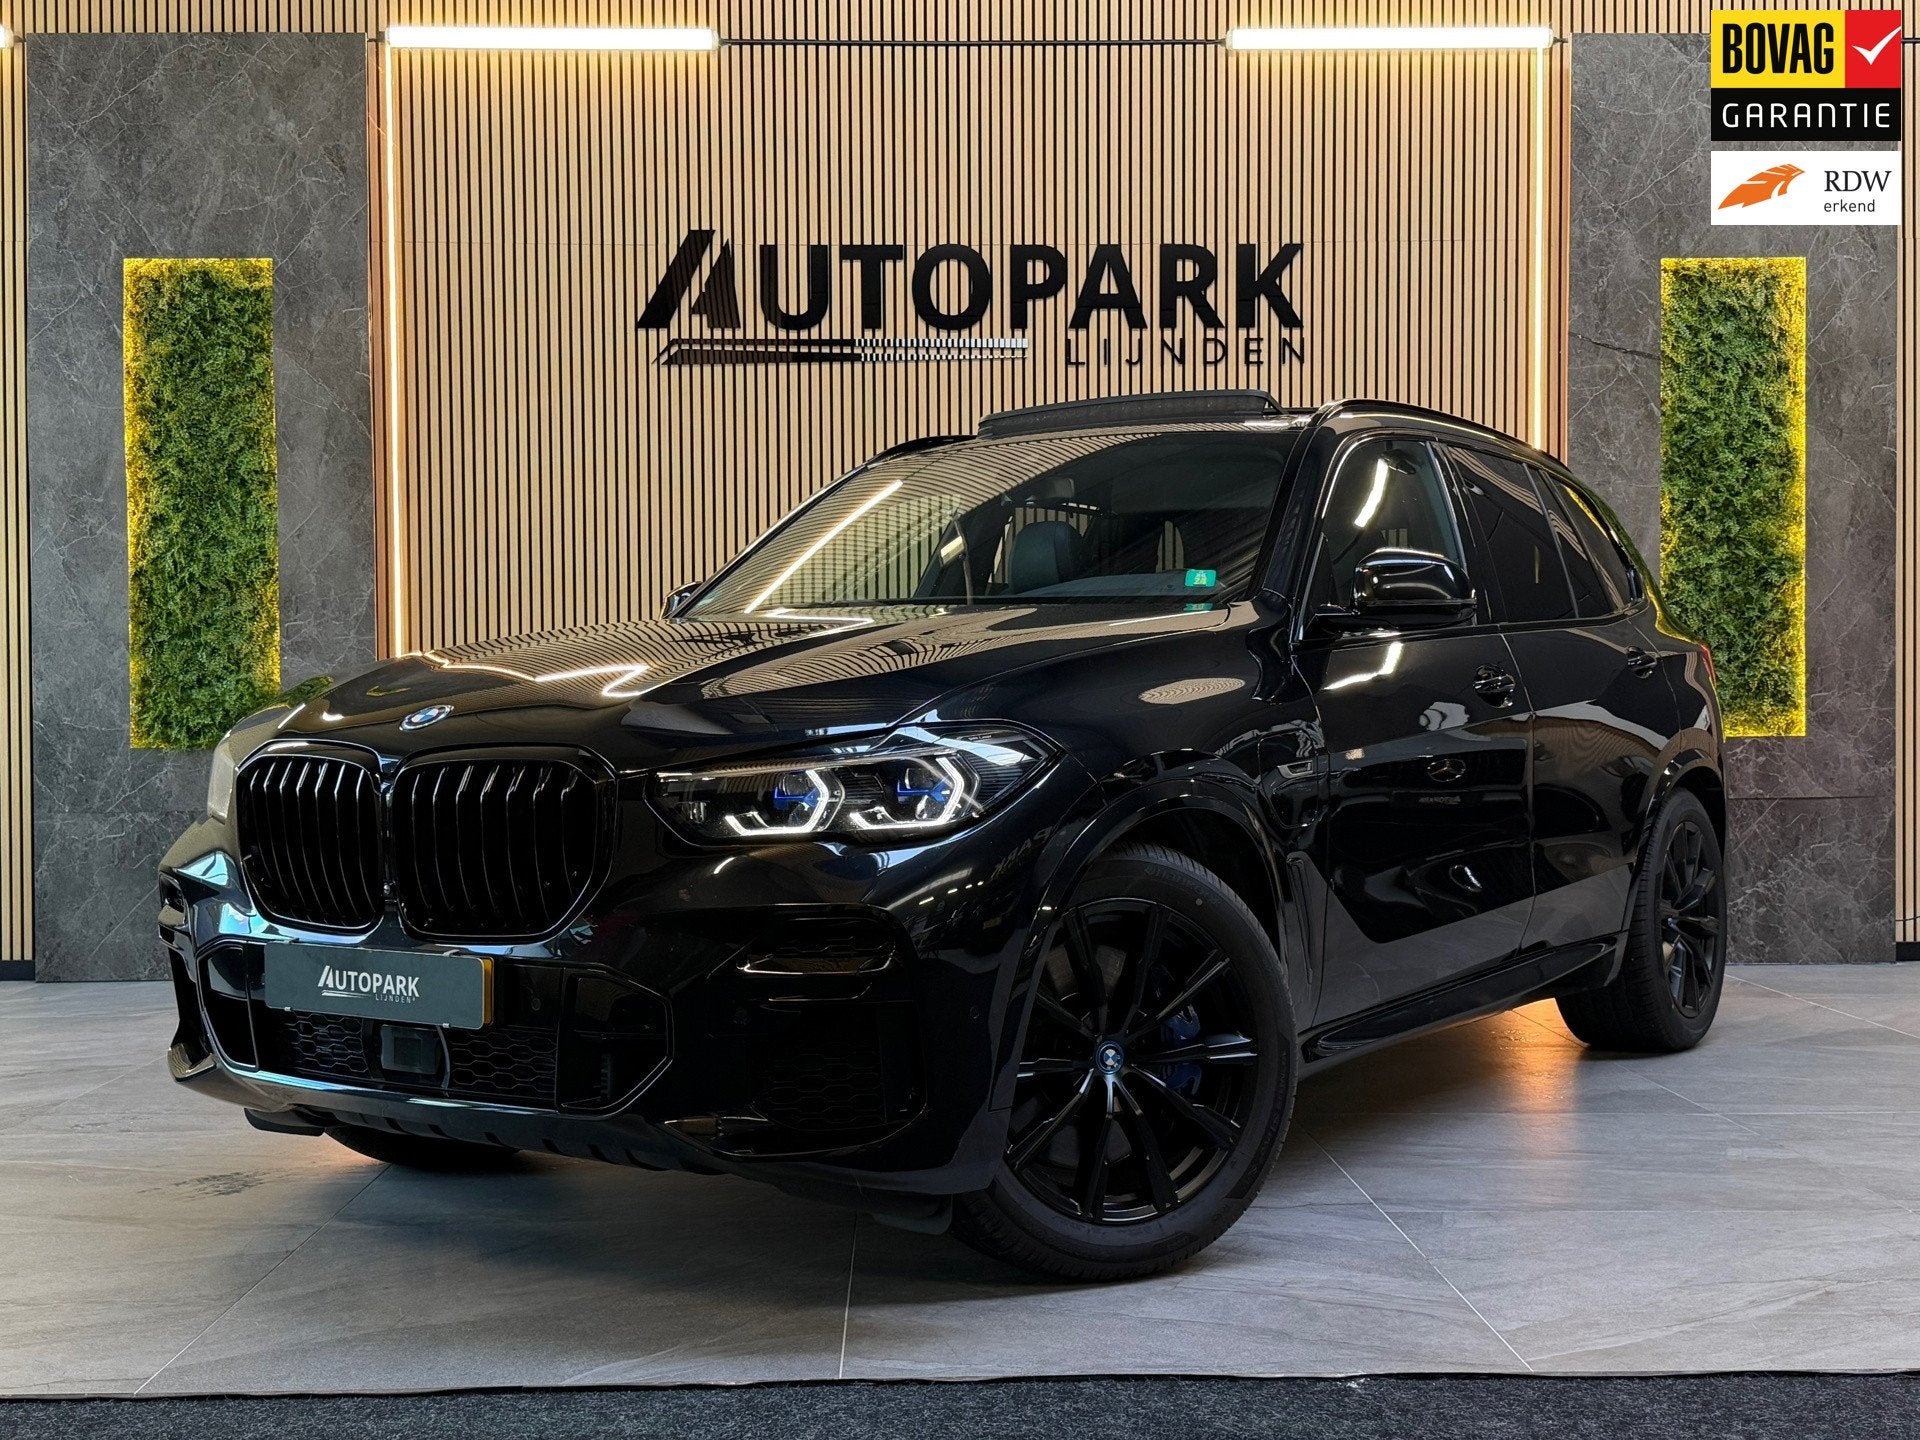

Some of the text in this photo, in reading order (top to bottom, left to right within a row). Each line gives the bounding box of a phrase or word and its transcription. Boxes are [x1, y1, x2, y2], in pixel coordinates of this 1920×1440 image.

[636, 229, 1304, 330] AUTOPARK
[1066, 338, 1304, 365] LIJNDEN
[317, 965, 419, 997] AUTOPARK
